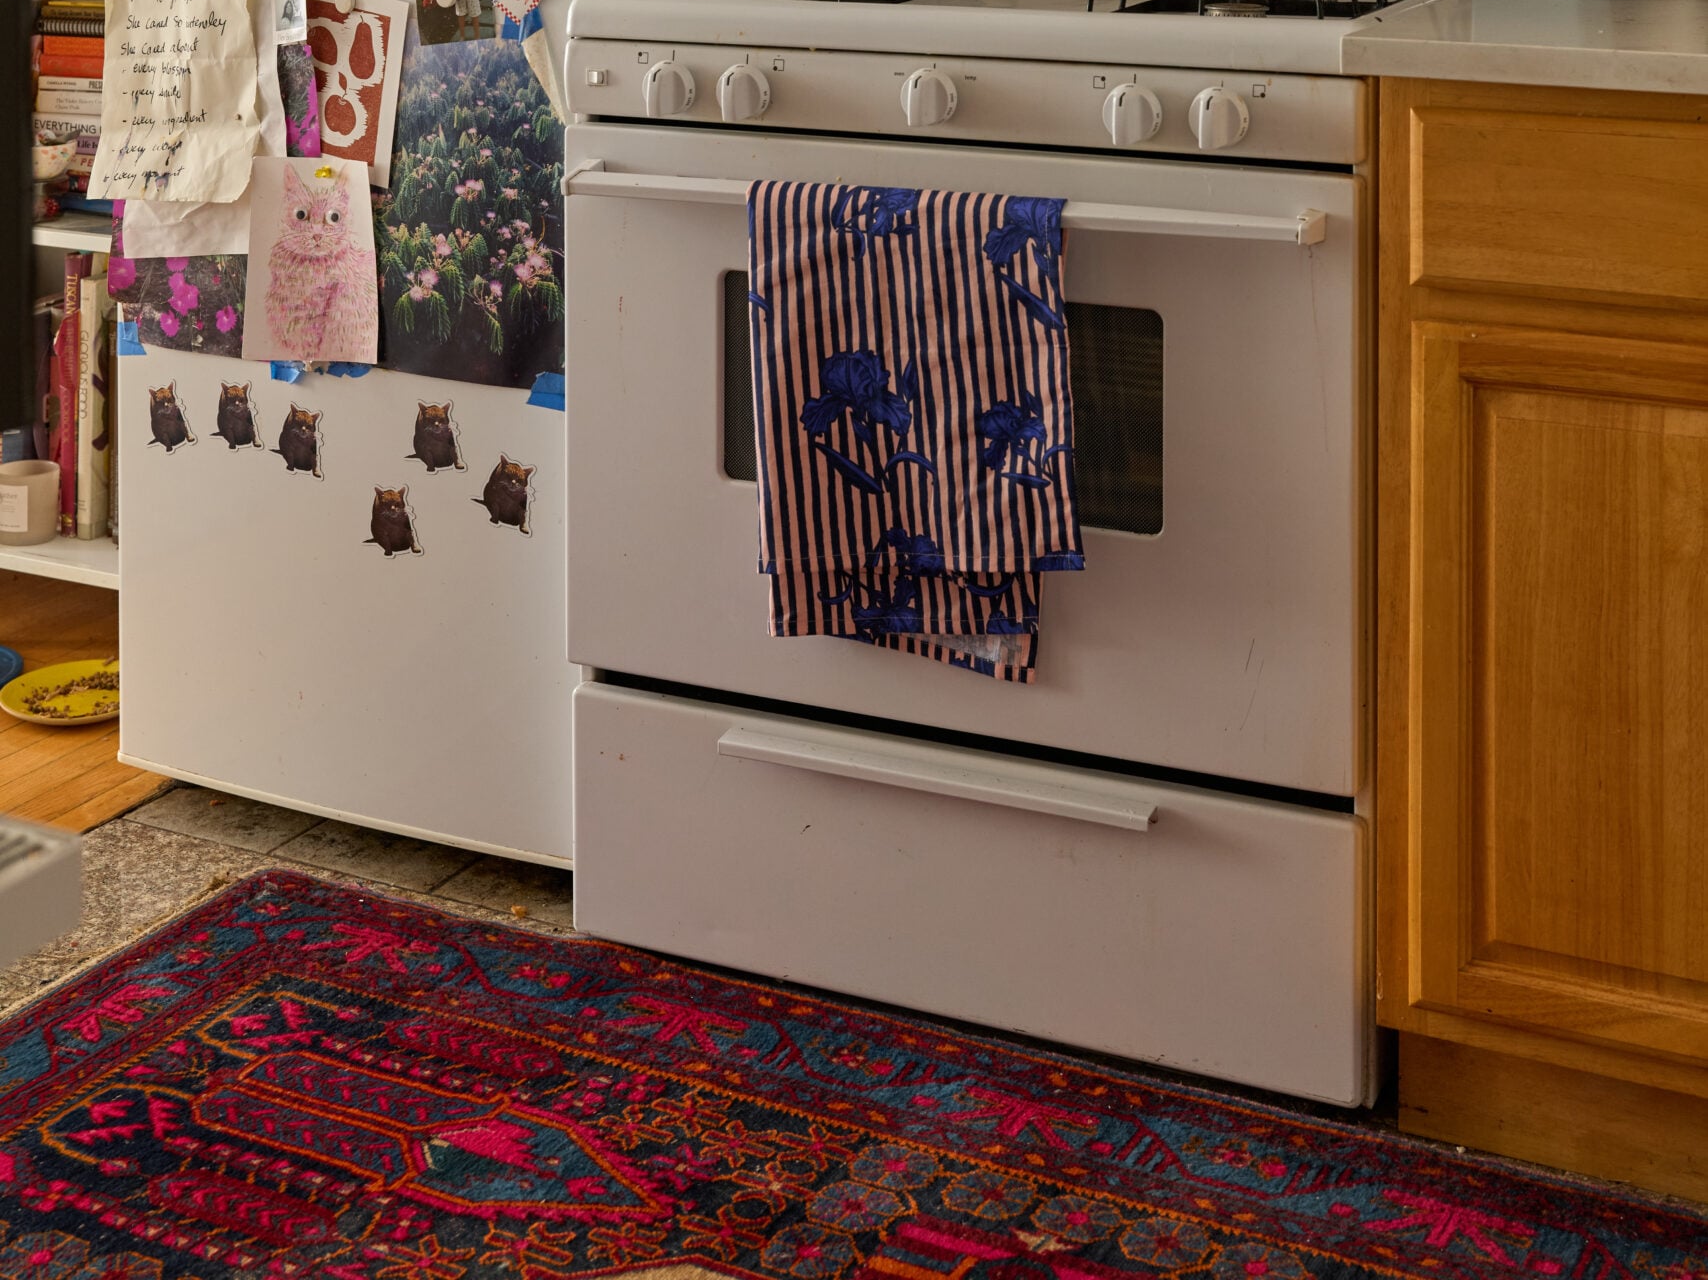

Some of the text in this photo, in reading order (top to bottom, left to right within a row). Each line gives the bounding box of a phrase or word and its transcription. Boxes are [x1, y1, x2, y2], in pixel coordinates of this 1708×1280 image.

[126, 15, 140, 29] She
[121, 41, 135, 56] She
[170, 37, 200, 53] about
[34, 120, 97, 134] EVERYTHING
